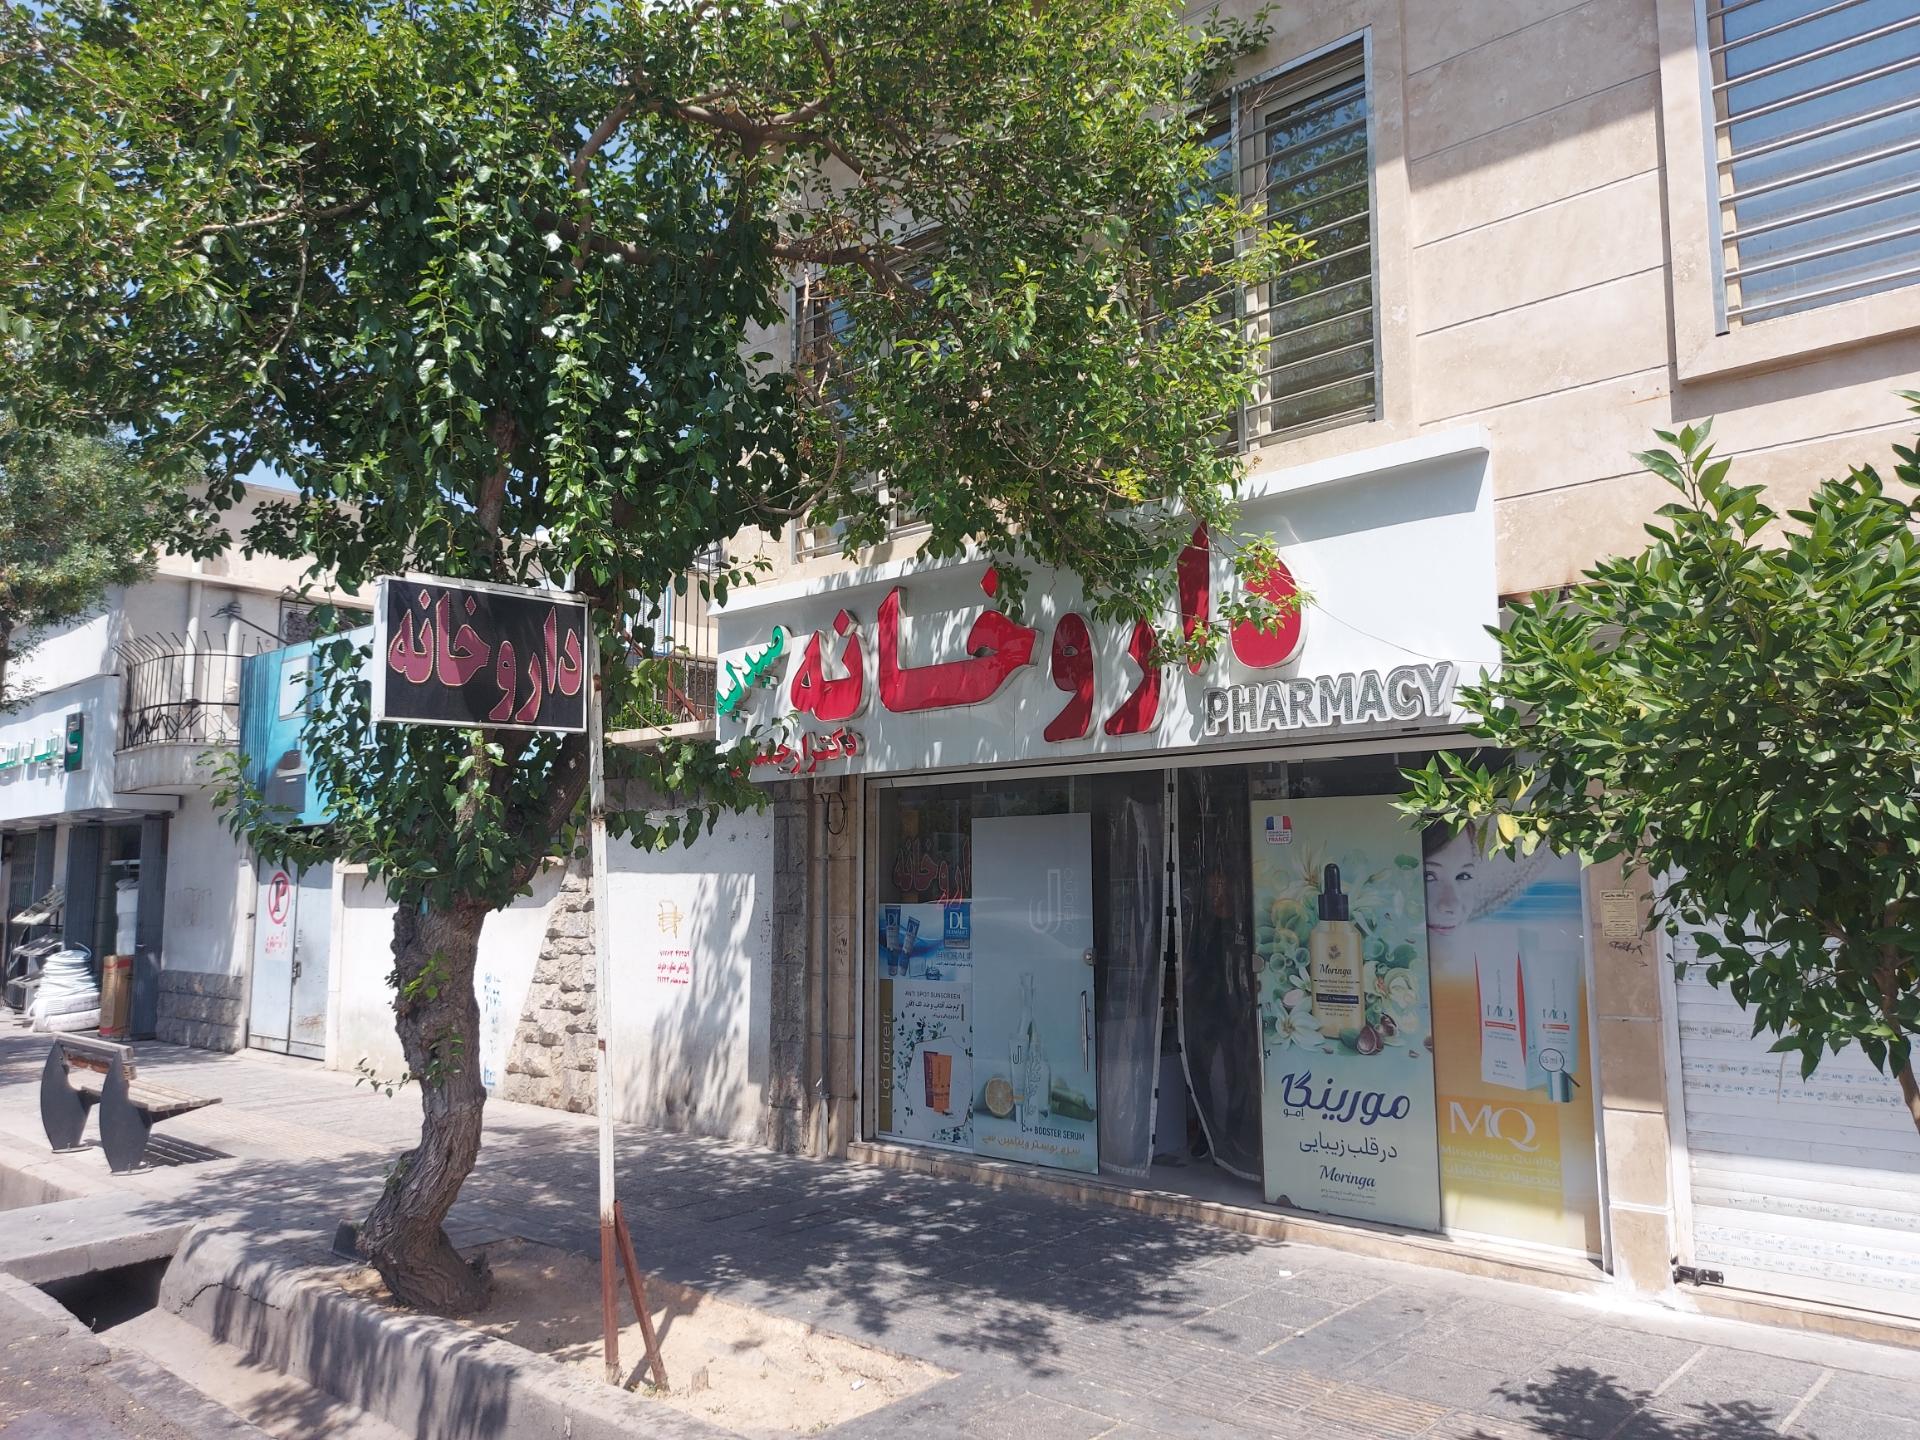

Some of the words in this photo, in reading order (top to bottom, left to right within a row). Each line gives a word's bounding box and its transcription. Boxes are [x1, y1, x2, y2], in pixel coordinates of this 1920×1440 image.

[387, 588, 583, 723] داروخانه
[1203, 661, 1456, 736] PHARMACY
[949, 911, 967, 930] DL
[930, 991, 961, 1000] SUNSCREEN
[1034, 1126, 1062, 1138] BOOSTER
[1063, 1130, 1085, 1141] SERUM
[1449, 1101, 1541, 1152] MQ
[1299, 1130, 1345, 1157] زیبایی
[1347, 1136, 1379, 1159] قلب
[1440, 1145, 1511, 1161] Miraculous
[1513, 1153, 1561, 1169] Quality
[1320, 1165, 1376, 1190] Moringa
